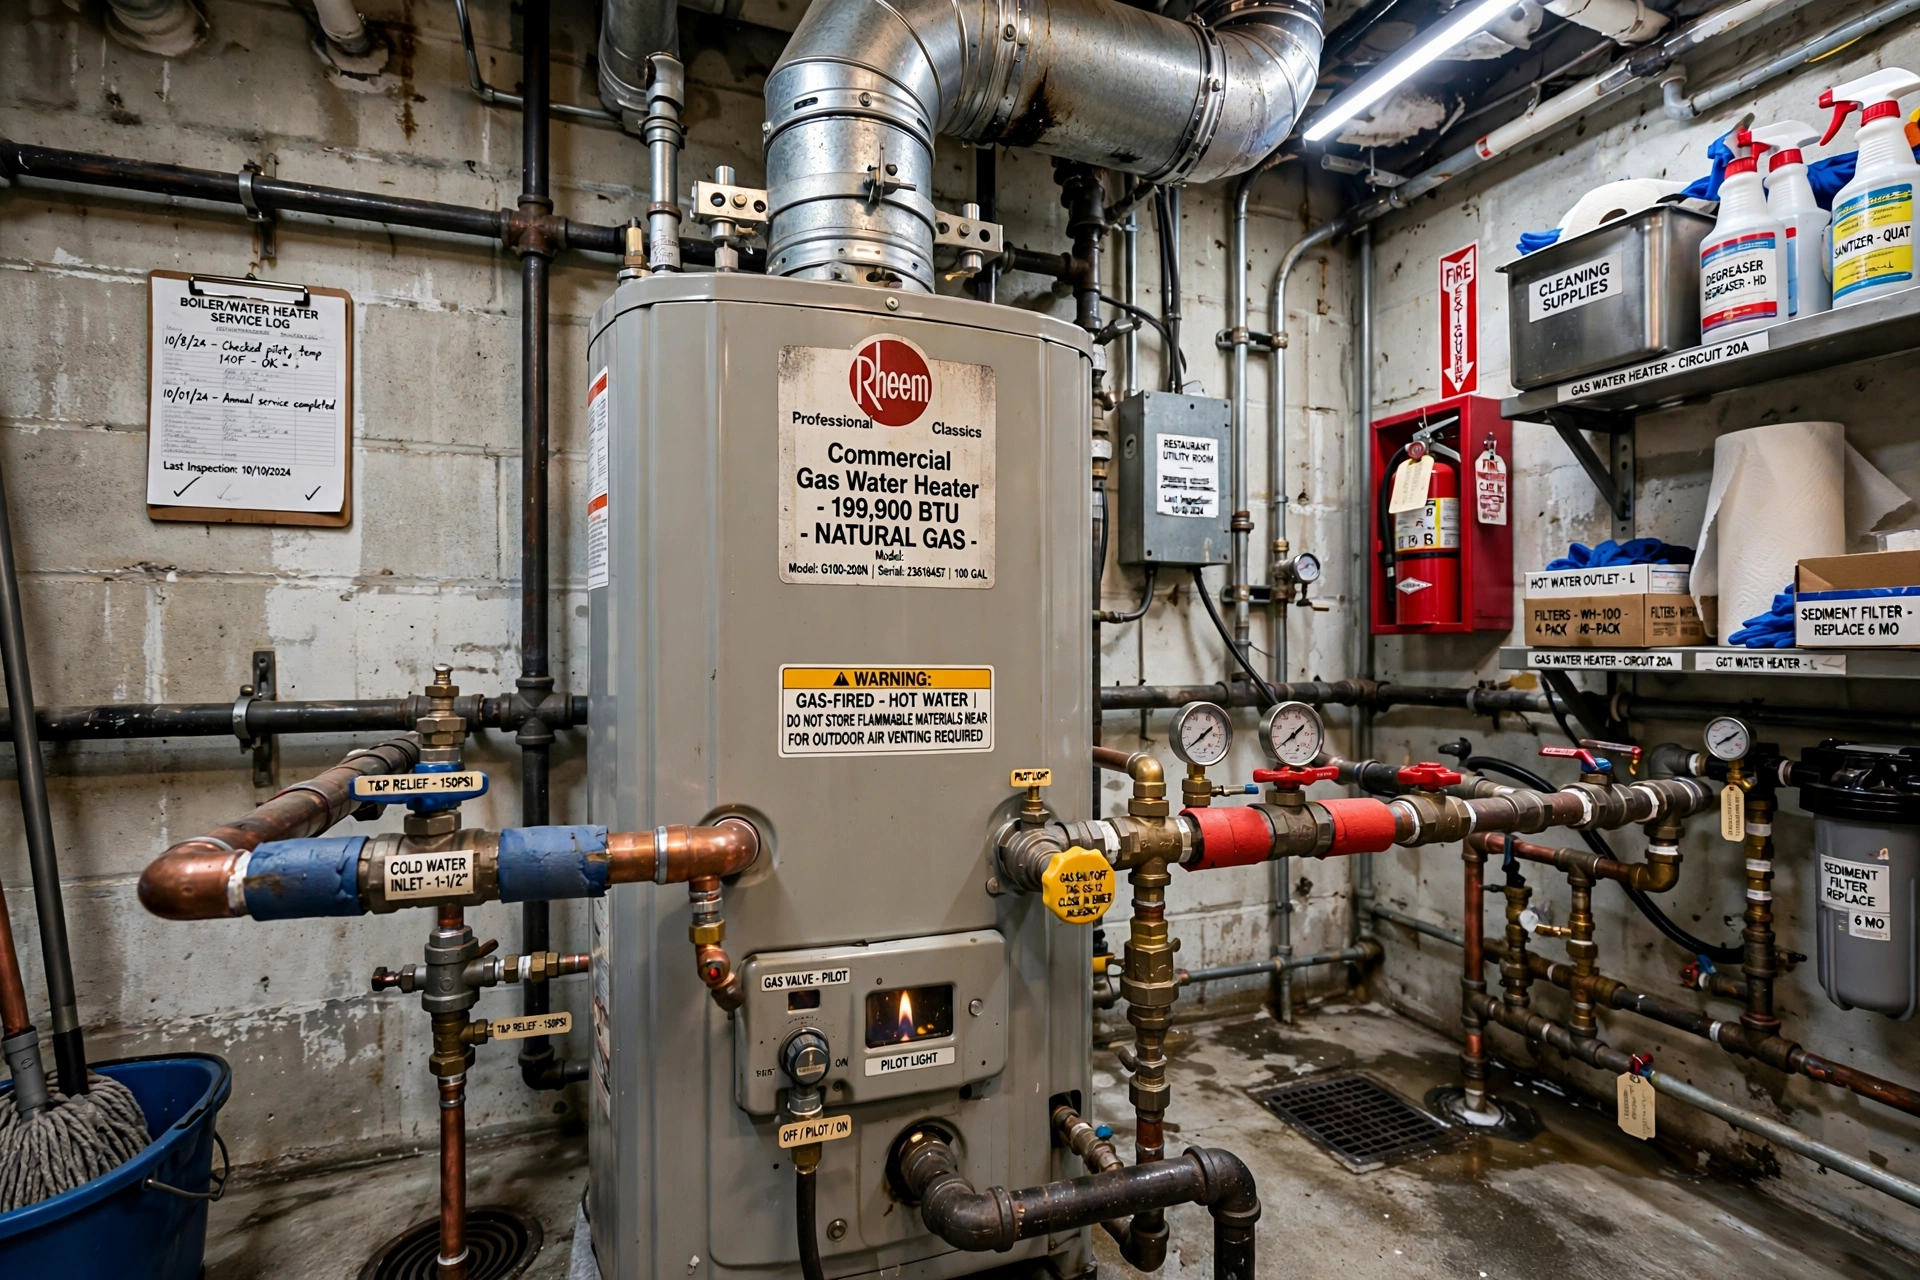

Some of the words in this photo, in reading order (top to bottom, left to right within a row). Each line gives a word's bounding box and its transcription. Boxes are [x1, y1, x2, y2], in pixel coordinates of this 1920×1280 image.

[1835, 234, 1873, 259] SANITIZER
[1884, 226, 1910, 242] QUAT
[1446, 262, 1471, 287] FIRE
[1539, 262, 1610, 297] CLEANING
[1706, 260, 1763, 287] DEGREASER
[1753, 275, 1767, 286] HD
[1543, 278, 1608, 312] SUPPLIES
[180, 297, 269, 316] BOILER/WATER
[274, 306, 319, 320] HEATER
[211, 313, 262, 328] SERVICE
[265, 318, 290, 329] LOG
[222, 341, 262, 354] Checked
[299, 345, 322, 361] temp
[262, 358, 278, 369] OK
[1571, 383, 1590, 396] GAS
[1593, 373, 1626, 392] WATER
[1629, 363, 1668, 381] HEATER
[1679, 348, 1722, 369] CIRCUIT
[1726, 341, 1749, 357] 20A
[856, 341, 929, 412] Rheem
[258, 397, 289, 408] service
[294, 399, 336, 412] completed
[792, 411, 873, 429] Professional
[932, 422, 982, 438] Classics
[828, 442, 951, 471] Commercial
[1163, 451, 1189, 462] UTILITY
[164, 461, 184, 472] Last
[187, 462, 238, 475] Inspection:
[242, 465, 291, 477] 10/10/2024
[797, 467, 840, 490] Gas
[846, 470, 908, 494] Water
[914, 474, 980, 499] Heater
[832, 497, 912, 521] 199,900
[919, 501, 959, 524] BTU
[815, 522, 916, 547] NATURAL
[923, 528, 966, 550] GAS
[789, 563, 819, 575] Model:
[955, 568, 969, 579] 100
[971, 569, 988, 580] GAL
[1531, 577, 1549, 589] HOT
[1551, 575, 1581, 588] WATER
[1584, 573, 1619, 586] OUTLET
[1535, 609, 1571, 622] FILTERS
[1581, 608, 1621, 620] WH-100
[1801, 606, 1858, 621] SEDIMENT
[1861, 605, 1903, 619] FILTER
[1536, 625, 1542, 634] 4
[1545, 623, 1567, 637] PACK
[1814, 623, 1865, 636] REPLACE
[1868, 623, 1875, 635] 6
[1879, 623, 1900, 636] MO
[1535, 655, 1551, 665] GAS
[1553, 655, 1582, 666] WATER
[1584, 655, 1616, 666] HEATER
[1656, 656, 1672, 667] 20A
[1736, 657, 1764, 669] WATER
[1767, 657, 1800, 669] HEATER
[854, 672, 932, 687] WARNING:
[796, 692, 874, 709] GAS-FIRED
[889, 692, 918, 708] HOT
[923, 692, 969, 708] WATER
[787, 714, 801, 728] DO
[803, 714, 824, 728] NOT
[826, 714, 855, 727] STORE
[858, 713, 913, 727] FLAMMABLE
[916, 712, 963, 726] MATERIALS
[965, 711, 988, 725] NEAR
[789, 732, 809, 746] FOR
[812, 731, 865, 745] OUTDOOR
[867, 731, 884, 744] AIR
[888, 730, 932, 744] VENTING
[934, 729, 983, 743] REQUIRED
[368, 780, 389, 792] T&P
[393, 778, 429, 791] RELIEF
[440, 776, 473, 789] 150PSI
[390, 860, 423, 876] COLD
[426, 858, 466, 873] WATER
[1824, 862, 1878, 881] SEDIMENT
[391, 877, 424, 892] INLET
[1830, 876, 1868, 894] FILTER
[1827, 887, 1876, 907] REPLACE
[1854, 915, 1862, 926] 6
[1865, 916, 1885, 929] MO
[764, 976, 784, 989] GAS
[786, 973, 814, 987] VALVE
[822, 970, 848, 983] PILOT
[881, 1057, 909, 1071] PILOT
[910, 1052, 938, 1067] LIGHT
[783, 1129, 798, 1142] OFF
[805, 1125, 829, 1140] PILOT
[836, 1121, 848, 1133] ON
